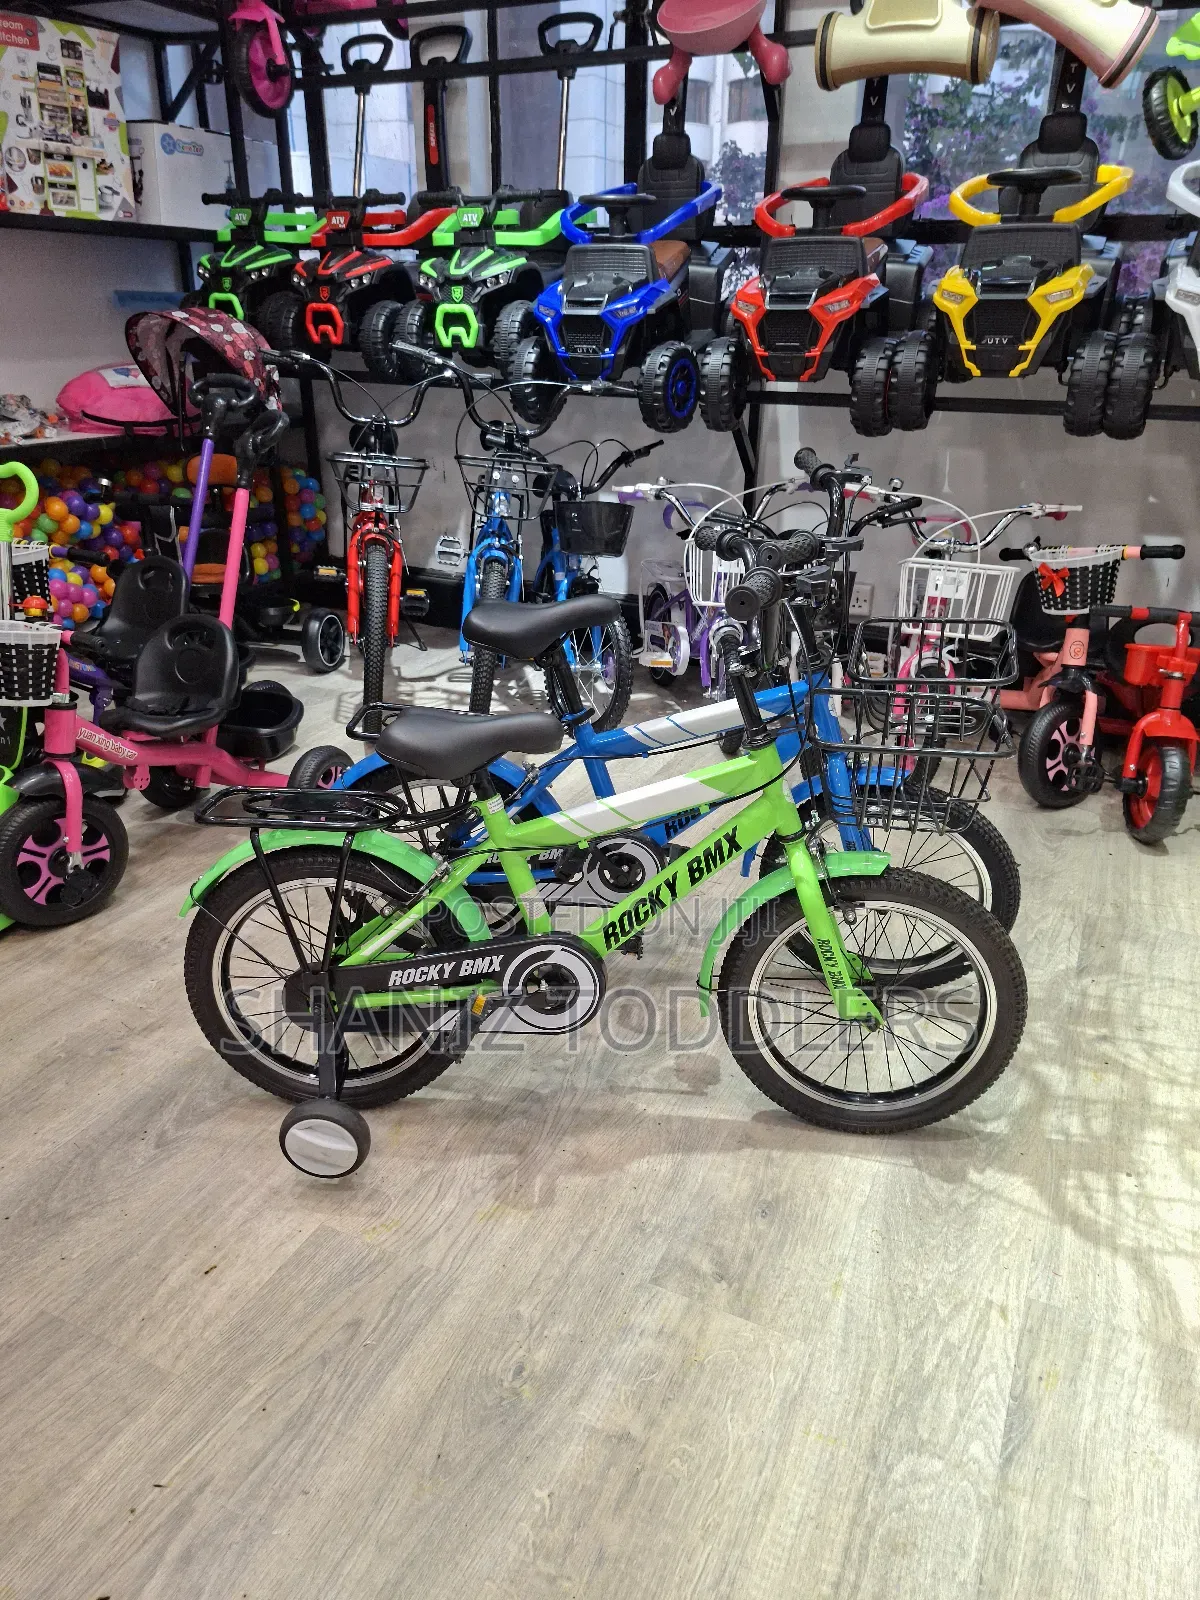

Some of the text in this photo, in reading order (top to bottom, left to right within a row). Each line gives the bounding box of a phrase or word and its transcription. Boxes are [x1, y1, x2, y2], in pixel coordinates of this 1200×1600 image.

[235, 213, 247, 221] ATV
[331, 216, 345, 225] ATV
[463, 213, 478, 222] ATV
[987, 337, 1008, 345] UTV
[76, 727, 138, 760] yuan xing baby car
[602, 870, 679, 952] ROCKY
[686, 824, 743, 888] BMX
[388, 954, 504, 987] ROCKY BMX
[816, 938, 848, 990] ROCKY BMX
